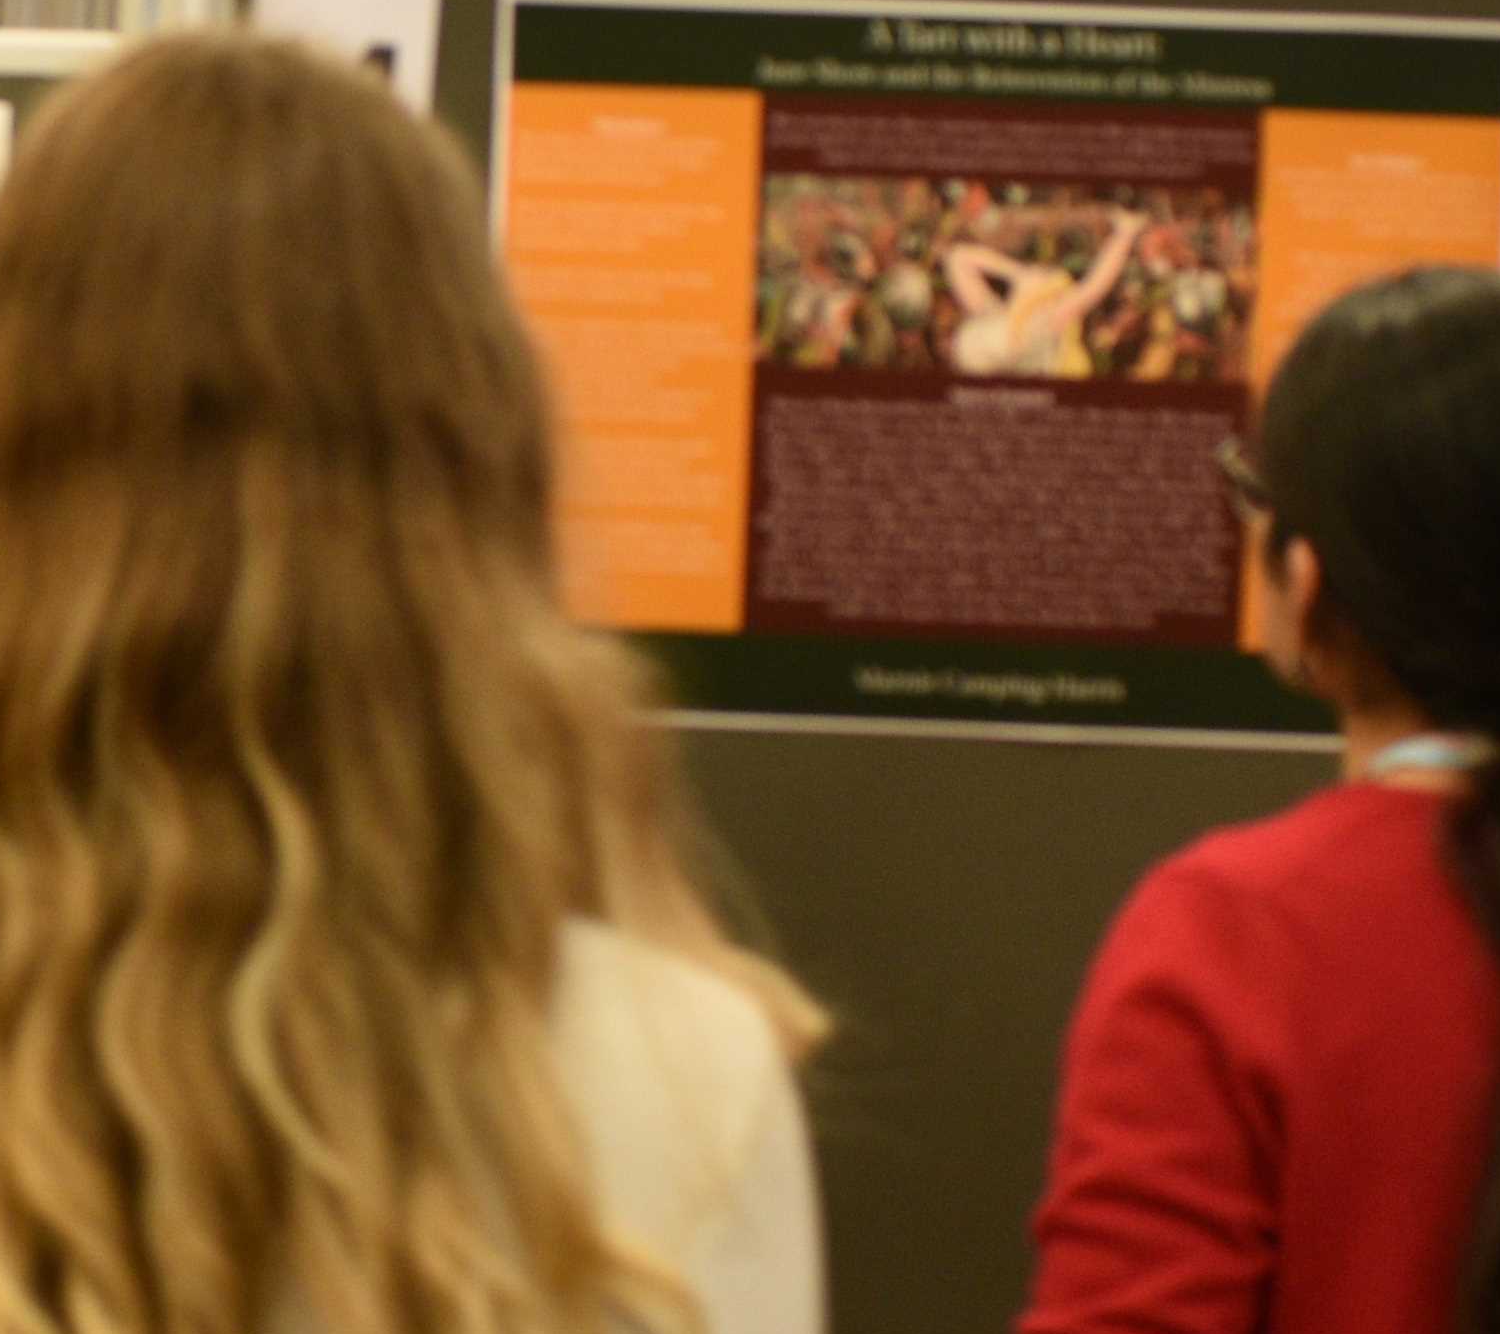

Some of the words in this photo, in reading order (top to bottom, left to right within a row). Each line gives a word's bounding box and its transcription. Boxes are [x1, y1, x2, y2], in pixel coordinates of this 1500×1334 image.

[867, 19, 894, 53] A
[900, 22, 958, 55] Tart
[964, 25, 1034, 58] with
[1040, 34, 1063, 59] a
[1066, 28, 1163, 62] Heart
[883, 61, 930, 89] and
[932, 62, 966, 90] the
[1138, 69, 1173, 97] the
